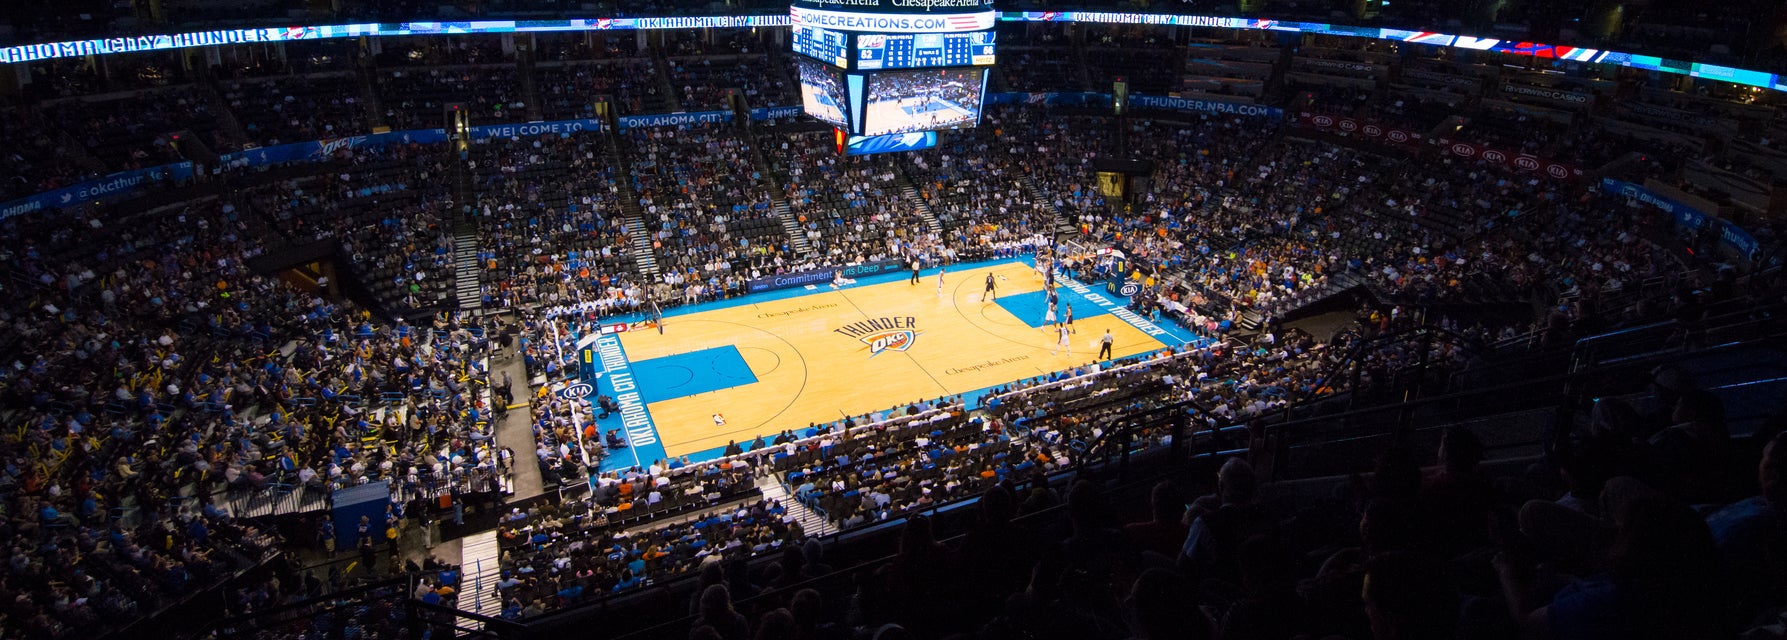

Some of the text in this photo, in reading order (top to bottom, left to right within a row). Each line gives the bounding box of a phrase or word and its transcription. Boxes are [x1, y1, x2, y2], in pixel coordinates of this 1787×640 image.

[638, 17, 716, 29] OKLAHOMA
[801, 12, 946, 29] HOMECREATIONS.COM
[168, 27, 270, 49] THUNDER
[1505, 84, 1586, 103] RIVERWIND CASINO
[1143, 96, 1268, 116] THUNDER.NBA.COM
[564, 122, 582, 132] TO
[628, 114, 695, 129] OKLAHOMA
[775, 264, 880, 287] Commitment uns Deep
[1084, 293, 1115, 307] CITY
[1107, 305, 1166, 336] THUNDER
[833, 316, 916, 339] THUNDER
[872, 331, 904, 354] OKC
[597, 336, 657, 447] OKLAHOMA CITY THUNDER
